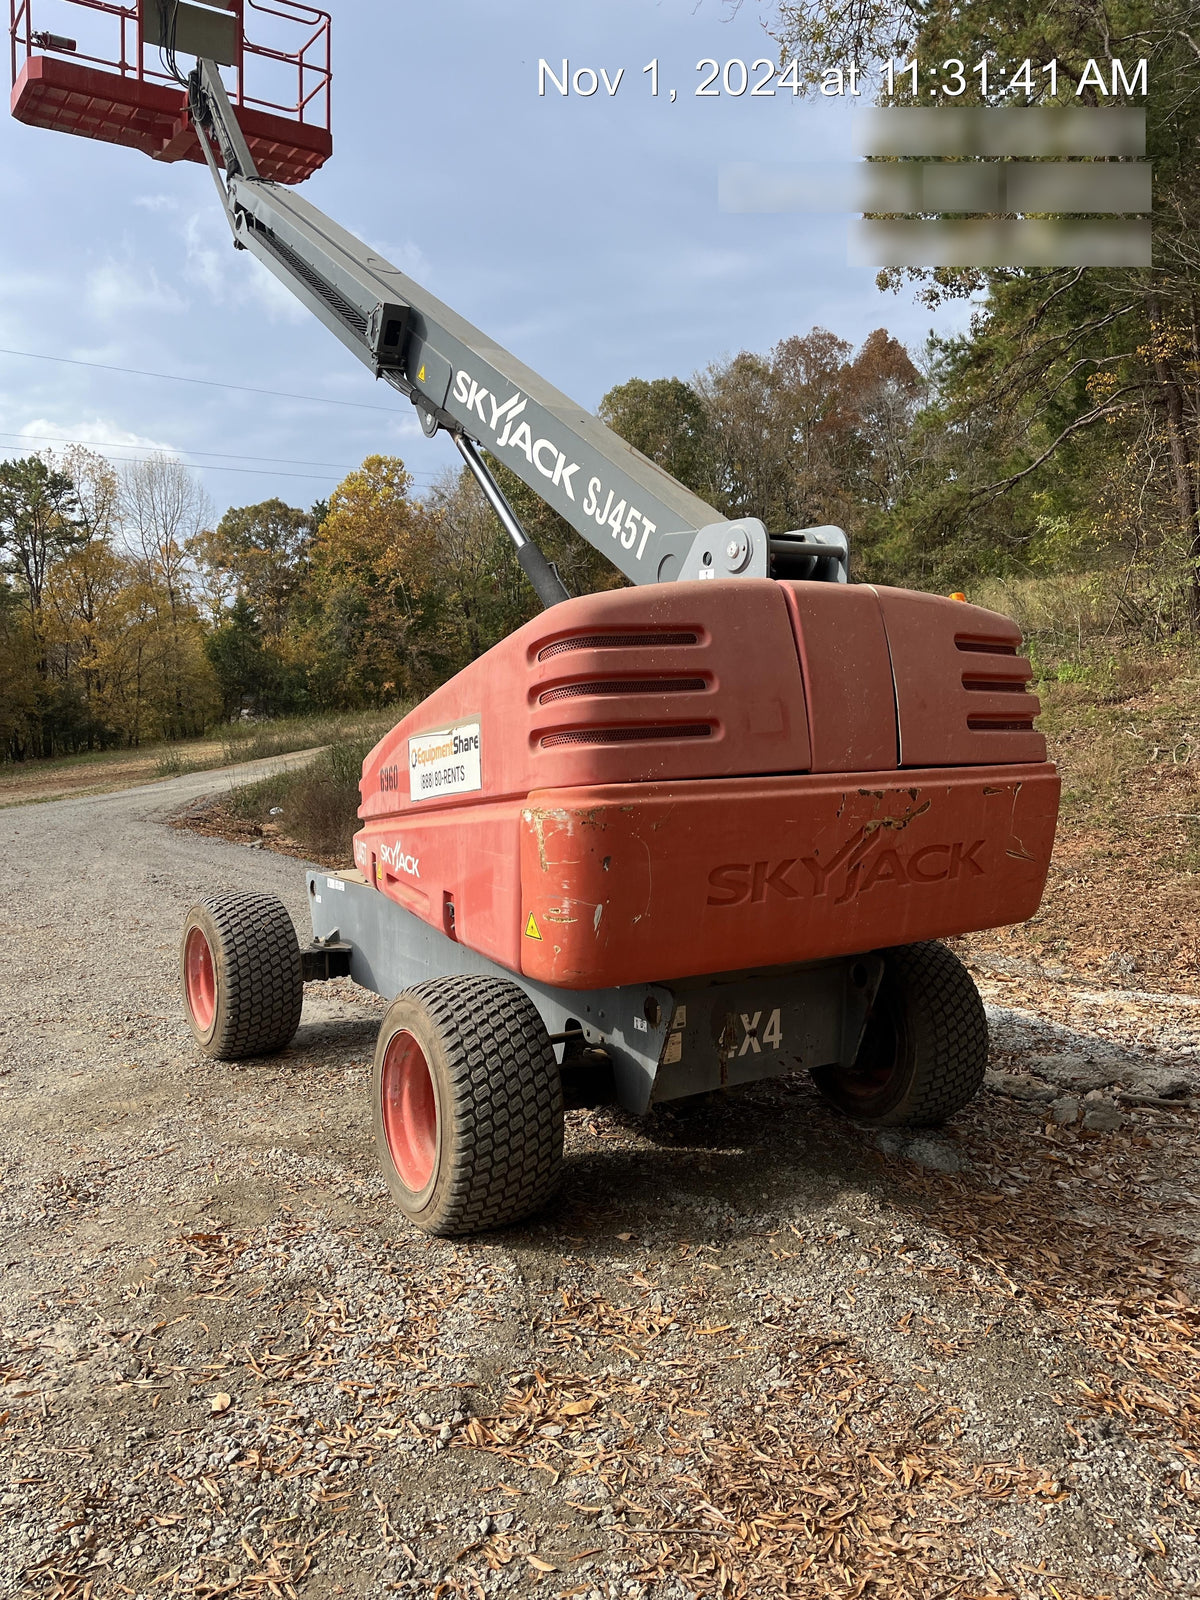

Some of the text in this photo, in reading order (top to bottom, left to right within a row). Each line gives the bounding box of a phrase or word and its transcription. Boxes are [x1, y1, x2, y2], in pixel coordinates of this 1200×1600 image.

[452, 370, 657, 561] SKYJACK SJ45T
[417, 735, 479, 766] EquipmentShare
[380, 764, 399, 792] 6960
[435, 765, 466, 787] 80-RENTS
[380, 840, 421, 878] SKYJACK
[706, 825, 986, 907] SKYJACK
